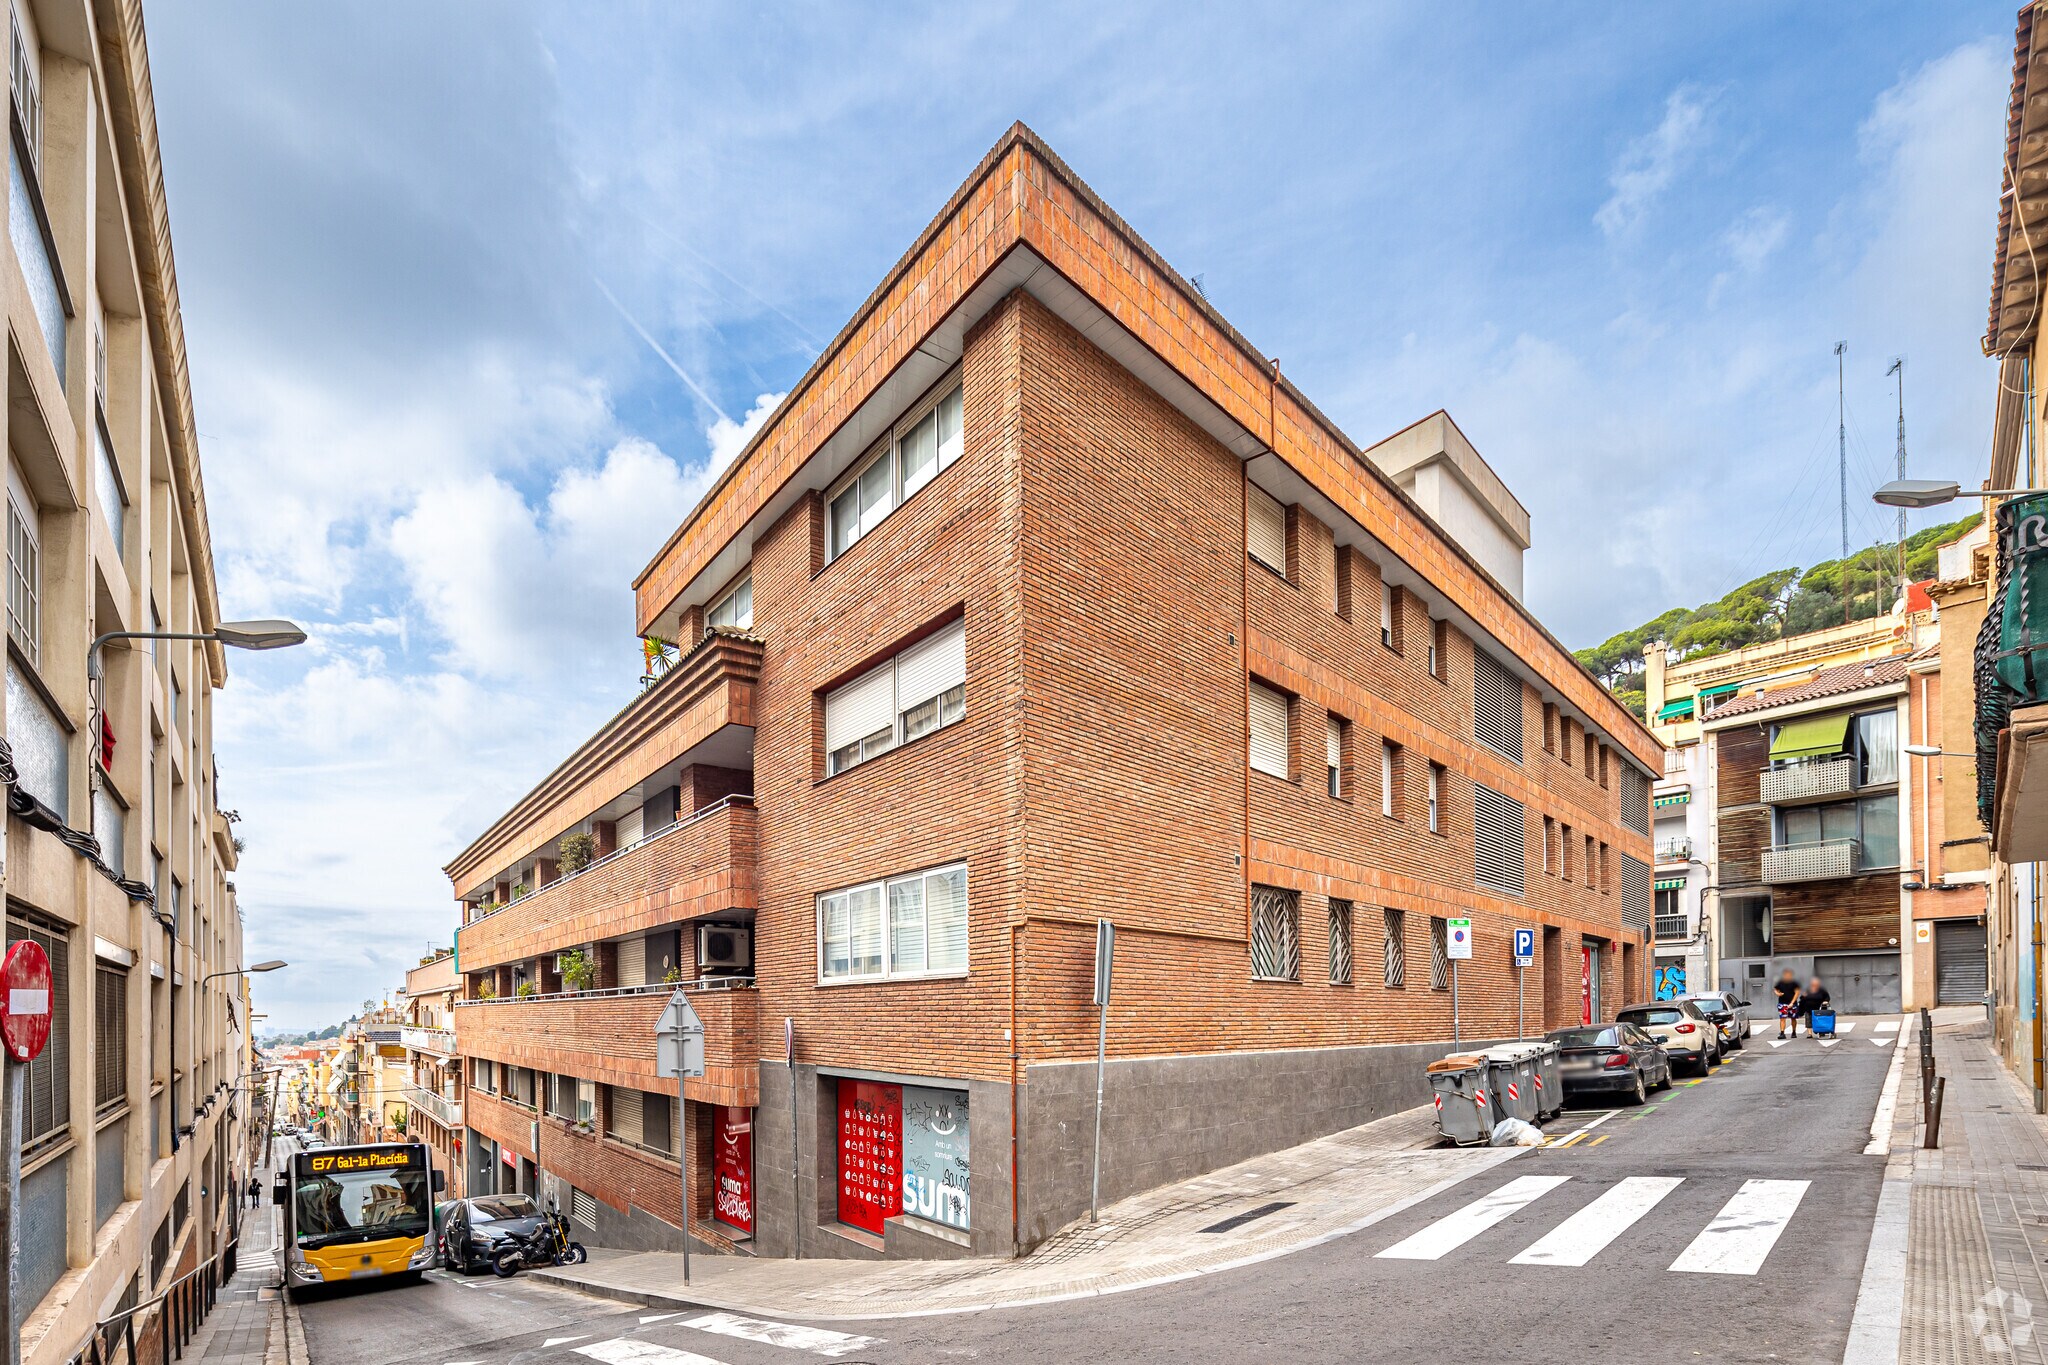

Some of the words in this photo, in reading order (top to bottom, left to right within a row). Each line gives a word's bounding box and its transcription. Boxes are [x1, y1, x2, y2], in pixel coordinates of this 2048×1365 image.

[1519, 932, 1531, 954] P
[312, 1157, 335, 1171] 87
[337, 1156, 369, 1168] Gal-la
[370, 1153, 408, 1166] Placídia
[721, 1176, 741, 1195] suma
[903, 1173, 970, 1228] sum
